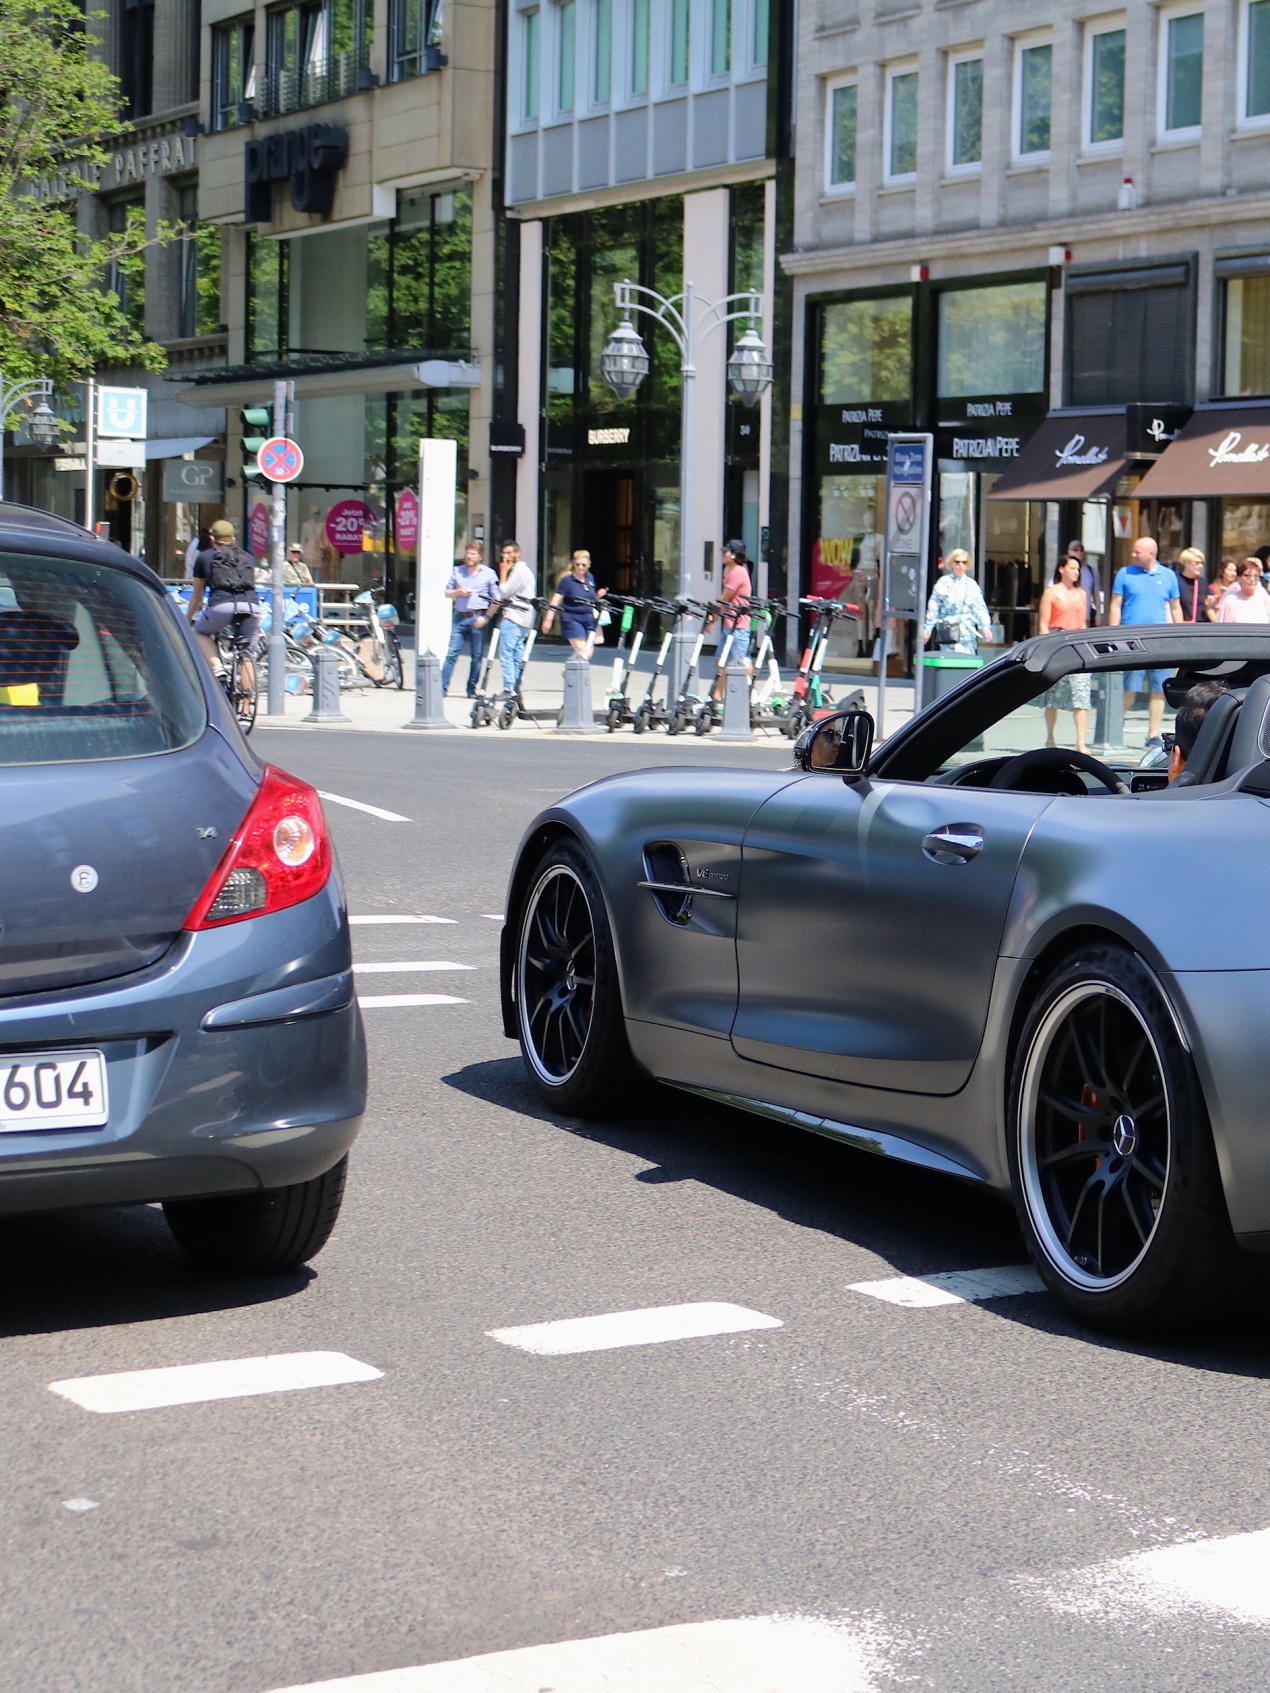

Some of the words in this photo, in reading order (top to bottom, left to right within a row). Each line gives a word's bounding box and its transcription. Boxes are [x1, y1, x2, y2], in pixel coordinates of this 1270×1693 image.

[996, 401, 1013, 416] PEPE
[588, 427, 630, 445] BURBERRY
[953, 437, 997, 458] PATRIZIA
[997, 435, 1021, 458] PEPE
[821, 538, 853, 564] WOW
[3, 1060, 94, 1112] 604
